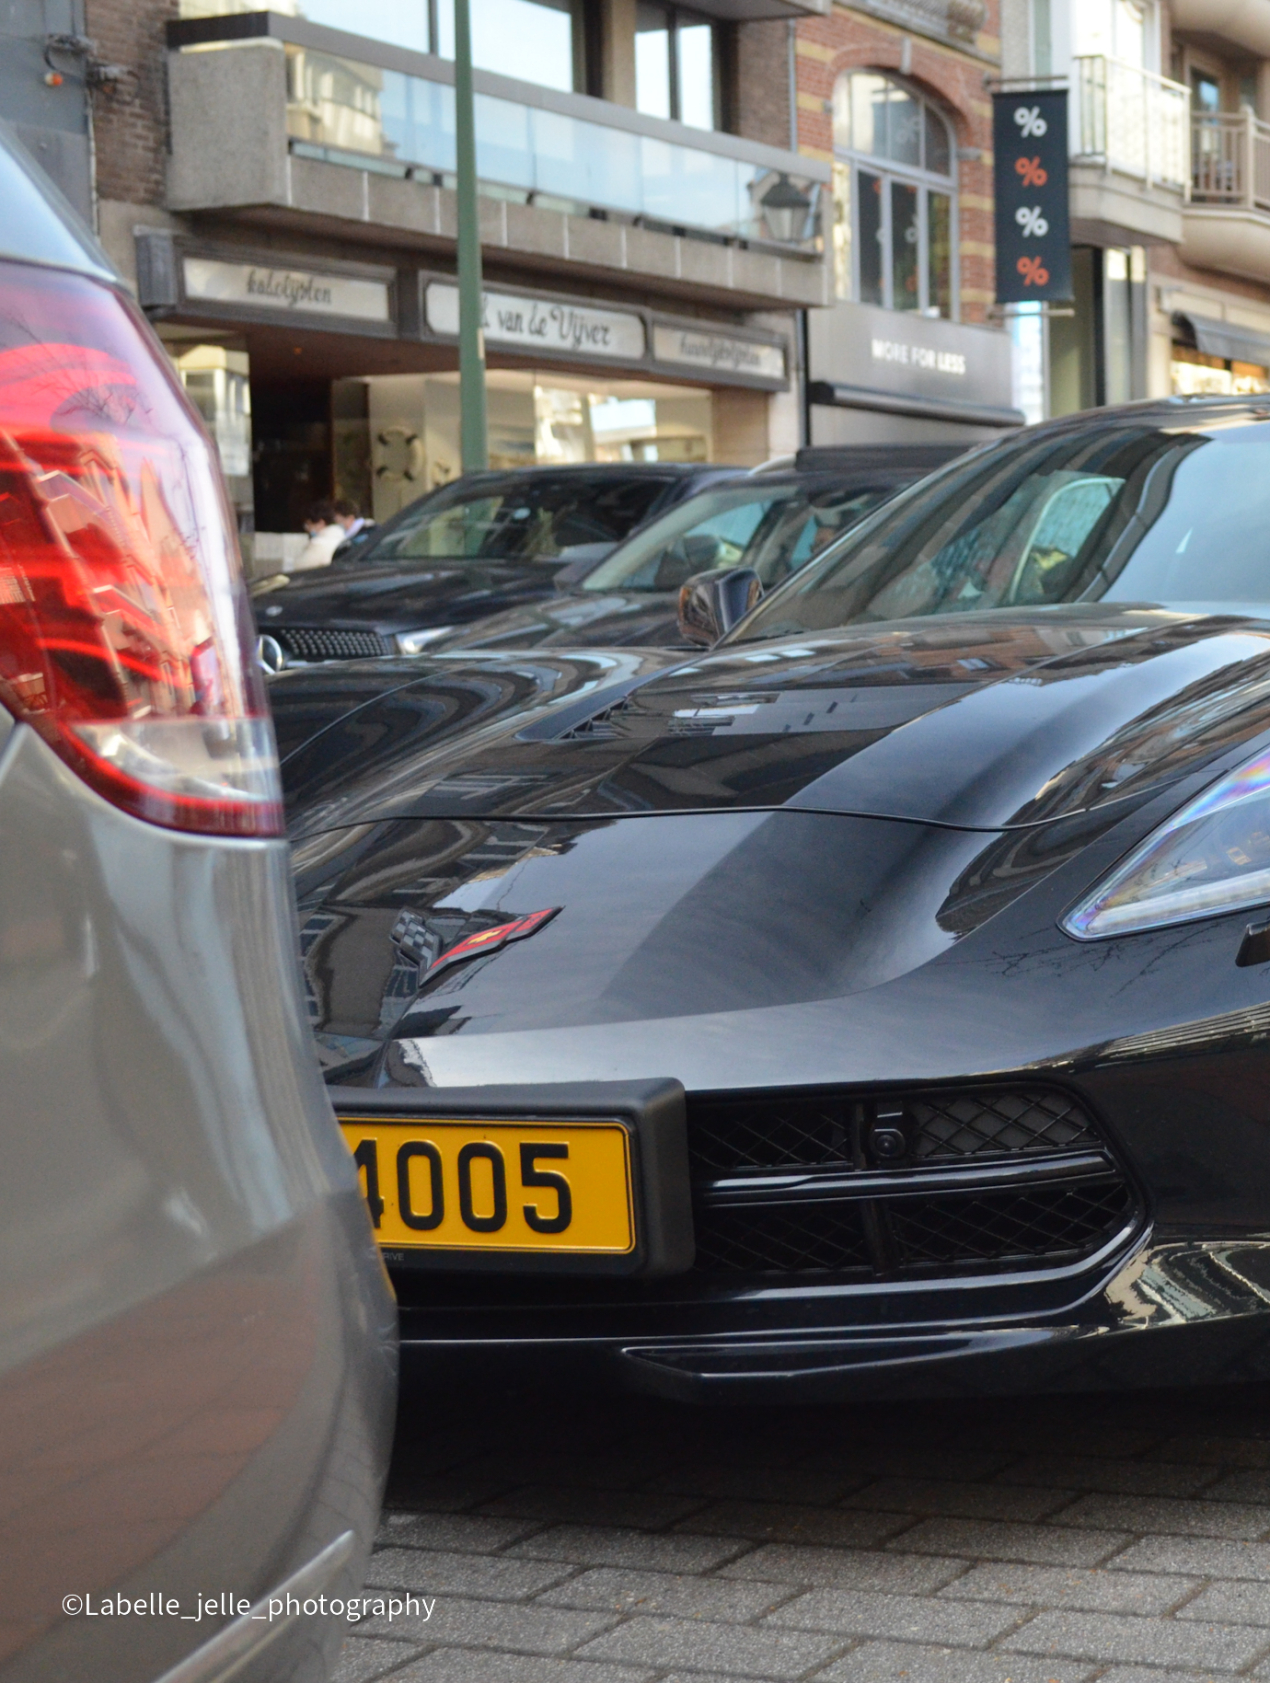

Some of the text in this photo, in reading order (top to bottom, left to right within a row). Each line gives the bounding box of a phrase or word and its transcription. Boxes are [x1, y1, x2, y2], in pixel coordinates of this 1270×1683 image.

[1014, 106, 1047, 138] %
[1014, 156, 1048, 187] %
[1015, 206, 1049, 237] %
[1016, 256, 1049, 286] %
[497, 308, 524, 333] van
[551, 304, 611, 350] Vijver
[872, 338, 966, 375] MORE FOR LESS
